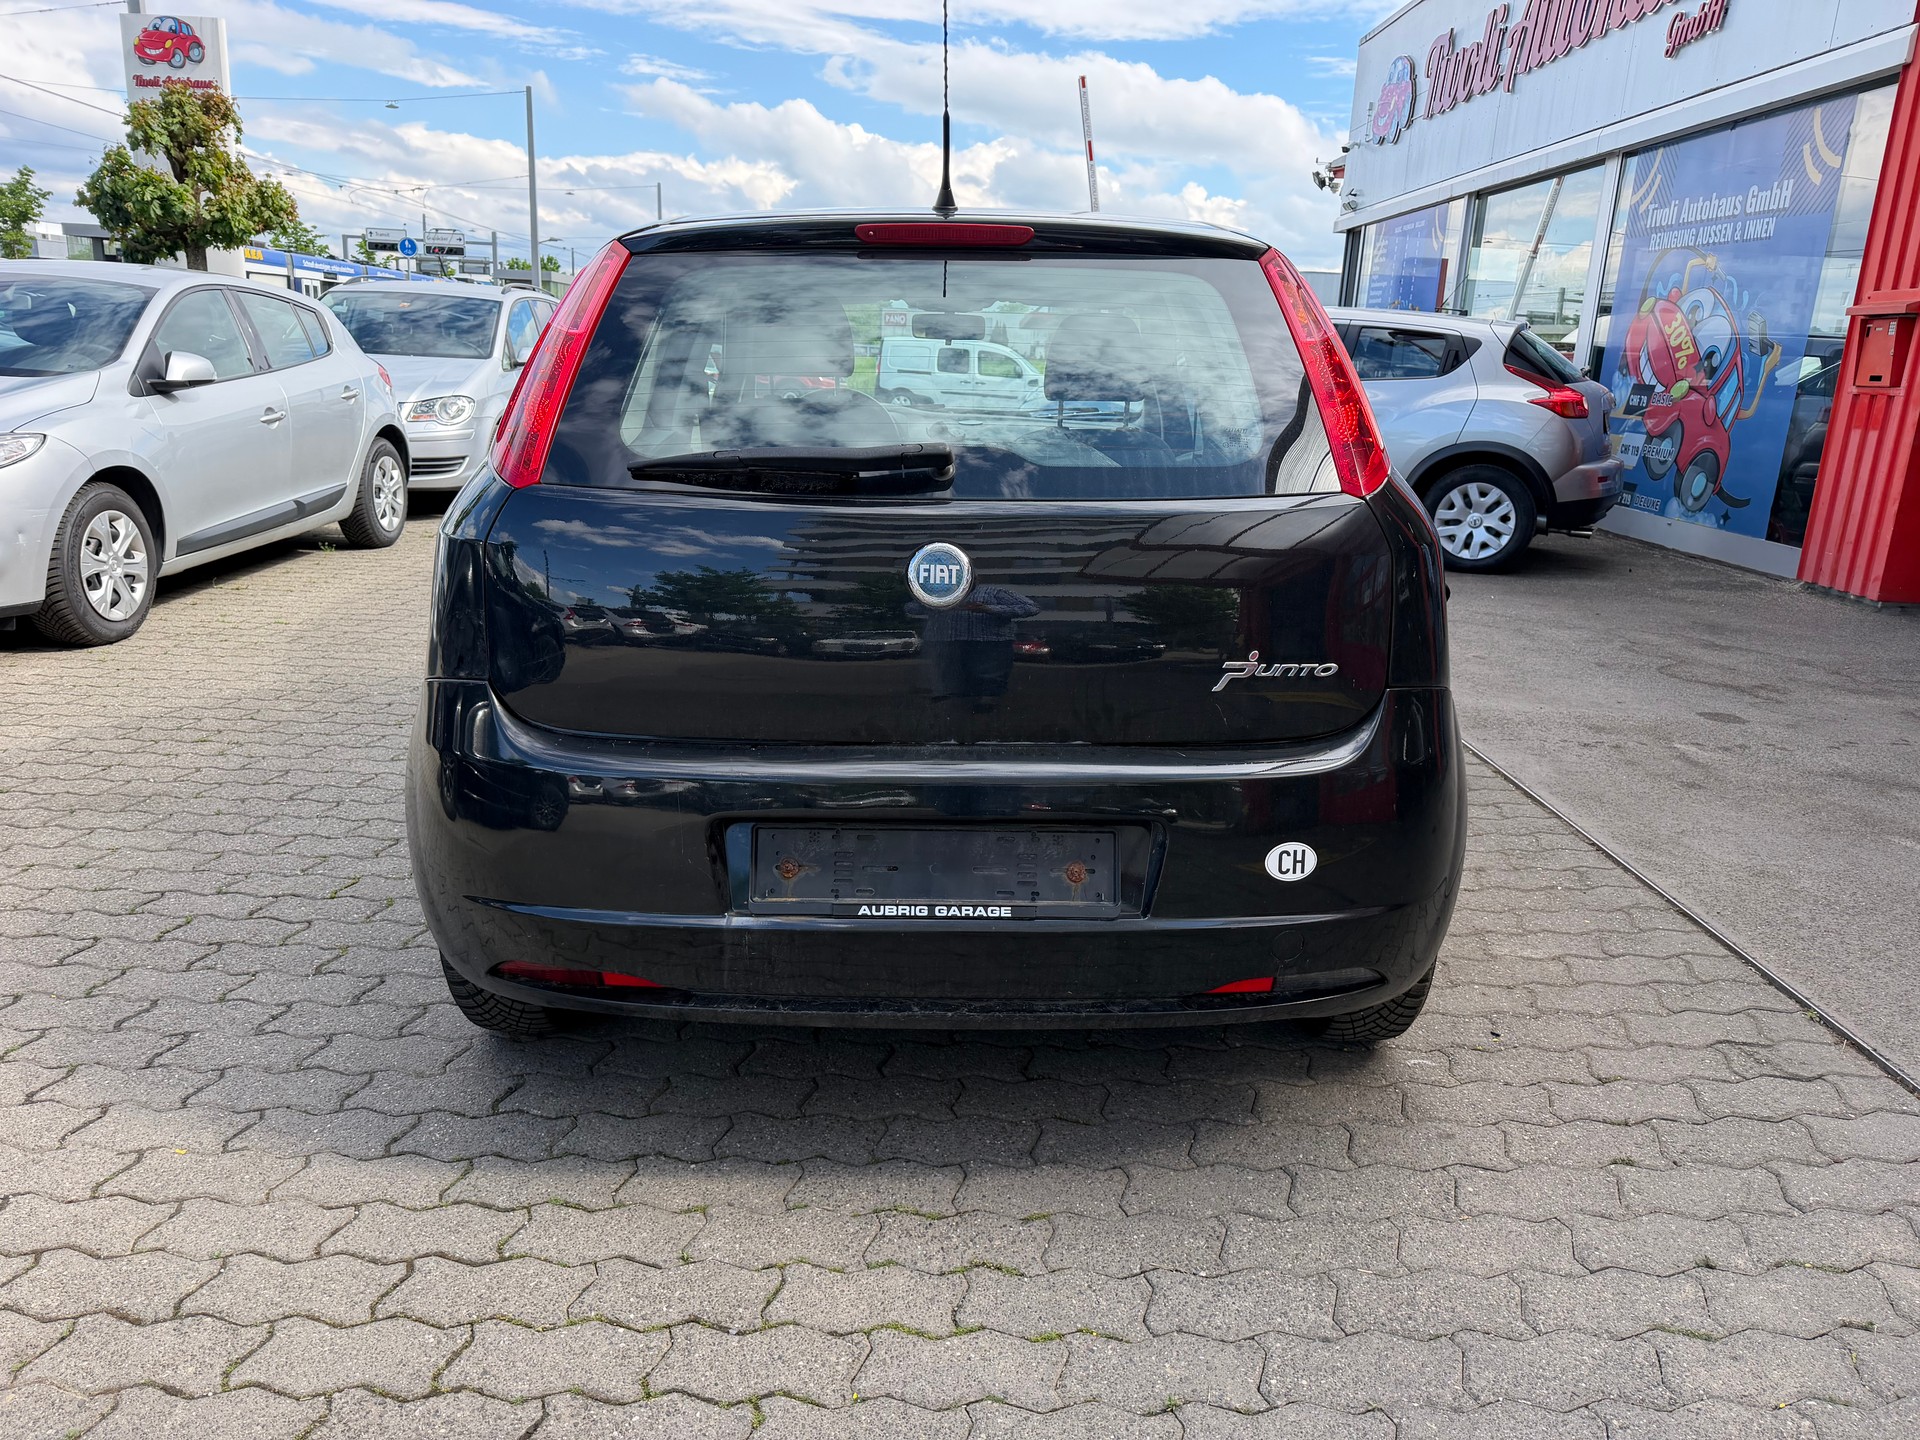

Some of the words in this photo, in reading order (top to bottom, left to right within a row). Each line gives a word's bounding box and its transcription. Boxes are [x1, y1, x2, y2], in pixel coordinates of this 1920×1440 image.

[1664, 0, 1726, 58] GmbH
[1424, 3, 1508, 119] Tivoli
[132, 74, 162, 87] Tivoli
[1646, 200, 1678, 228] Tivoli
[1679, 192, 1743, 224] Autohaus
[1744, 178, 1794, 214] GmbH
[1649, 227, 1696, 251] REINIGUNG
[1696, 222, 1734, 246] AUSSEN
[1733, 221, 1742, 240] &
[1743, 216, 1776, 240] INNEN
[1664, 312, 1695, 370] 30%
[1650, 392, 1674, 407] BASIC
[1641, 443, 1675, 460] PREMIUM
[1634, 493, 1661, 512] DELUXE
[919, 564, 960, 585] FIAT
[1278, 849, 1306, 875] CH
[857, 905, 928, 916] AUBRIG
[934, 906, 1012, 917] GARAGE
